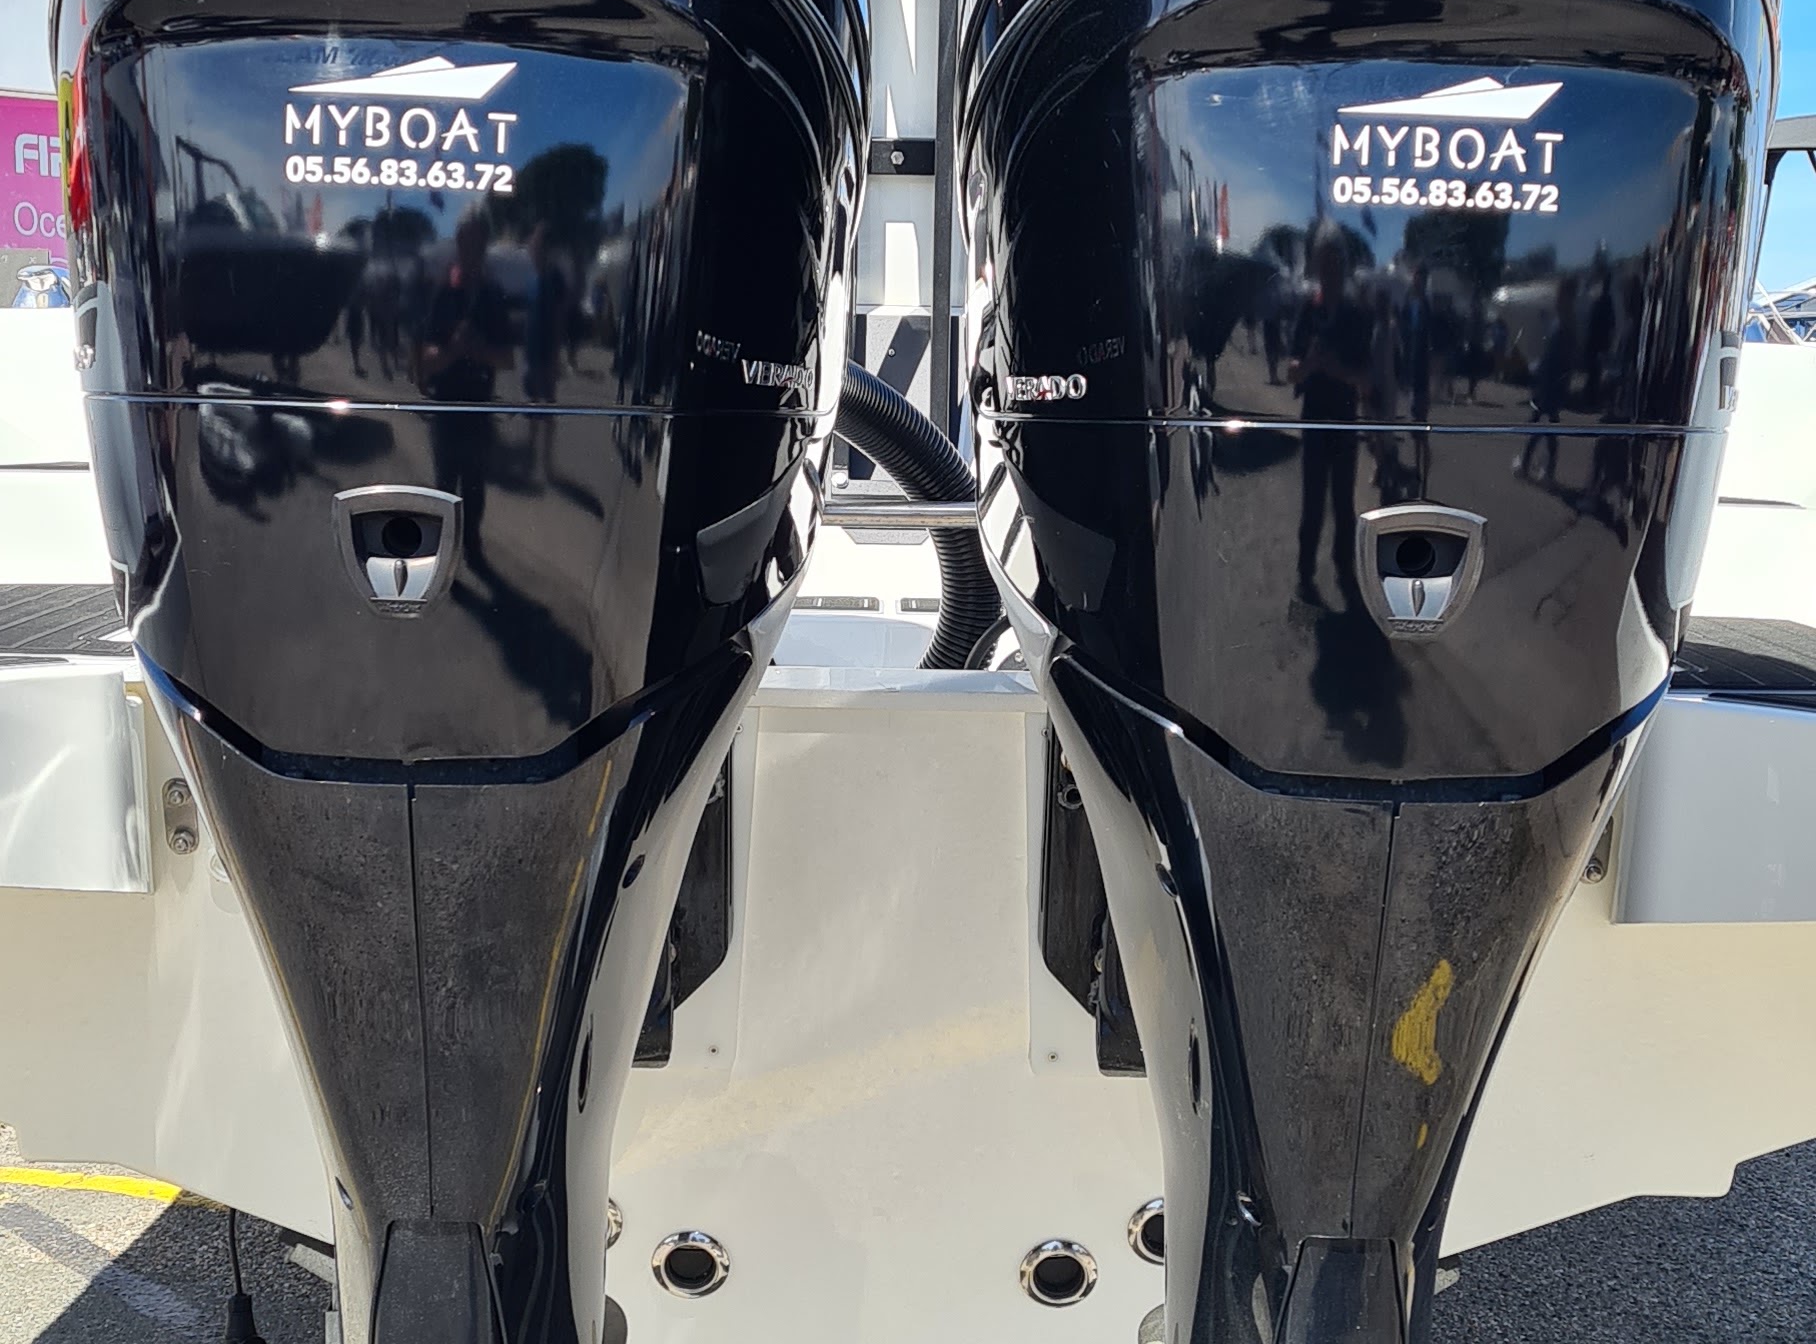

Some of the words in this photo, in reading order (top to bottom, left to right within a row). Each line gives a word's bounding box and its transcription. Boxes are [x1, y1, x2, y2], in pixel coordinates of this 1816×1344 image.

[284, 103, 518, 155] MYBOAT
[1332, 123, 1565, 175] MYBOAT
[285, 155, 513, 193] 05.56.83.63.72
[1332, 175, 1560, 213] 05.56.83.63.72
[741, 358, 816, 391] VERADO
